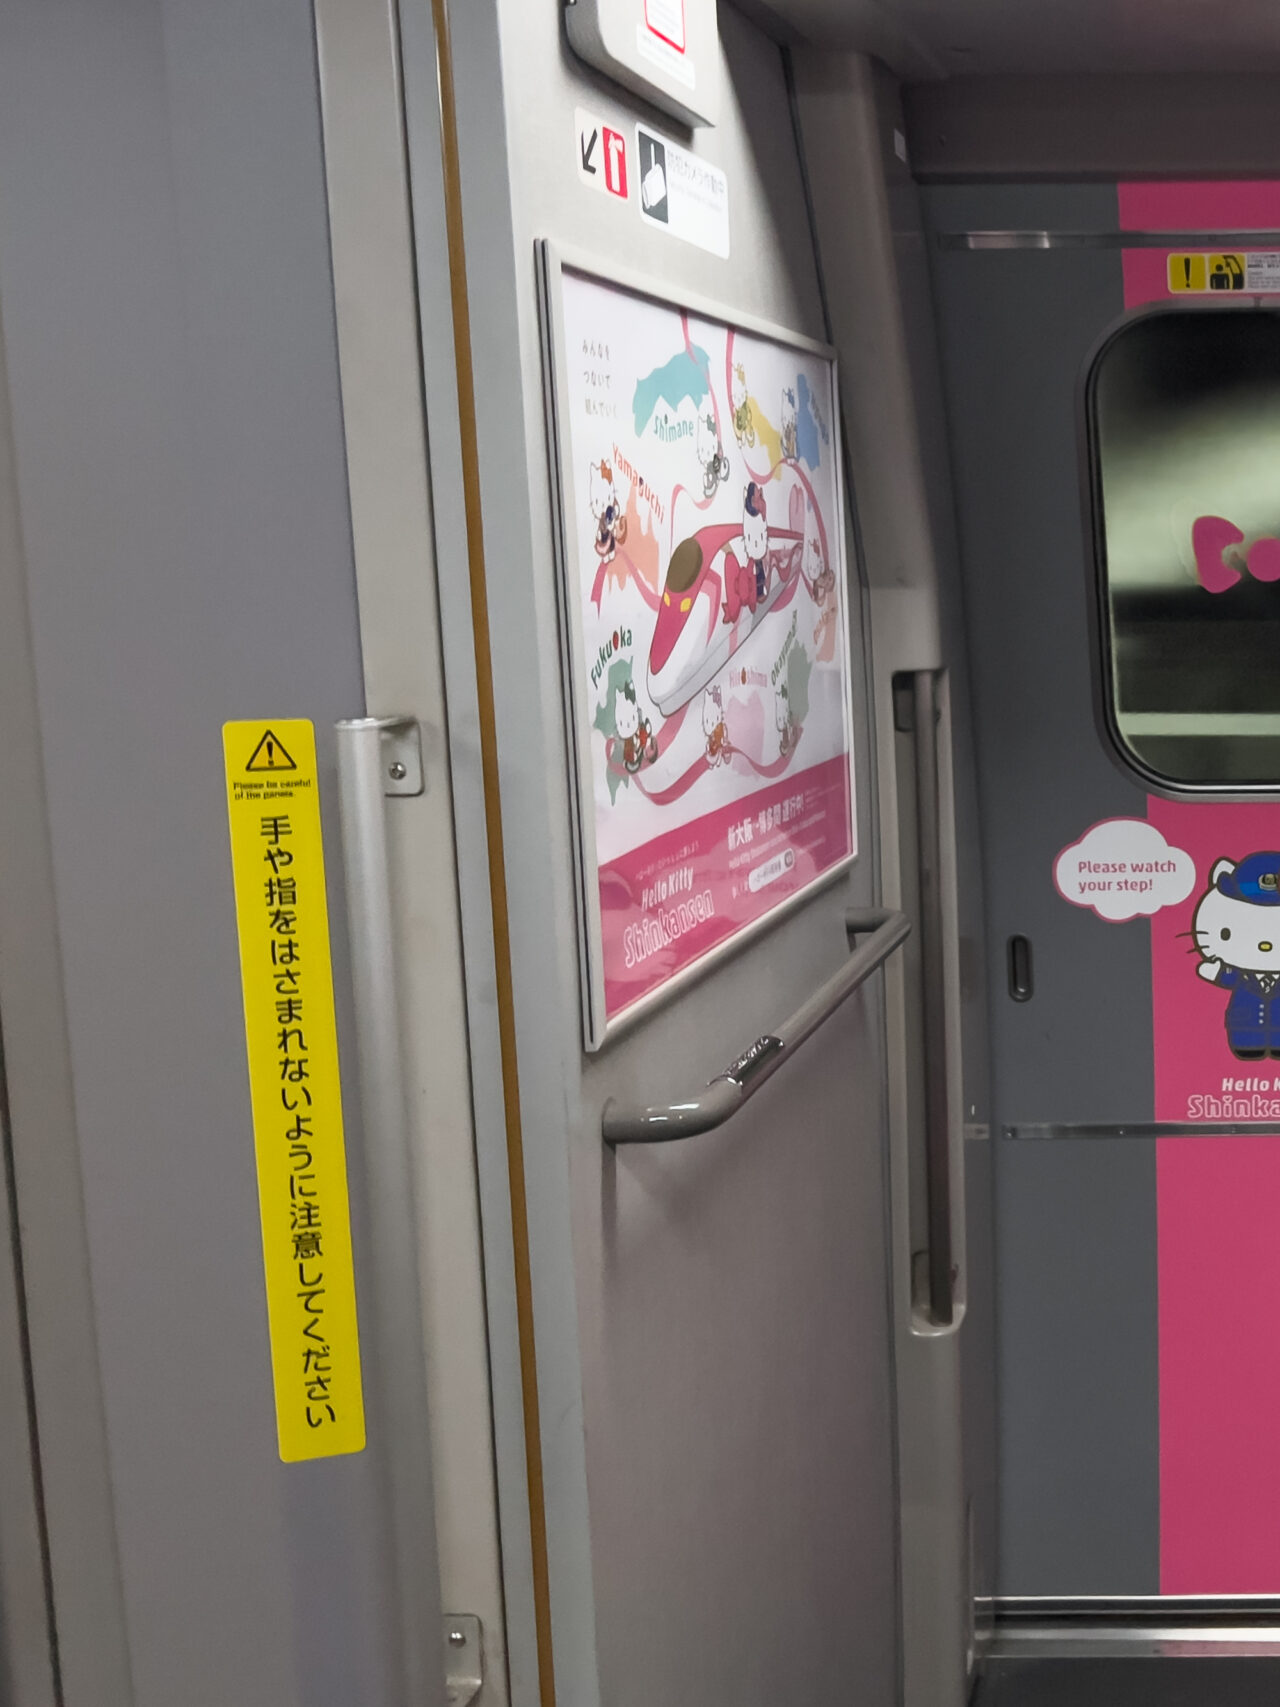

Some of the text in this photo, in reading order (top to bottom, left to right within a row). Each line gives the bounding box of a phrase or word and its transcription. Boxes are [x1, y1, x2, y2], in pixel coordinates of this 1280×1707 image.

[653, 414, 694, 442] Shimane
[612, 441, 664, 525] Yamaguchi
[1078, 860, 1177, 873] Please watch
[641, 879, 668, 912] Hello
[668, 866, 694, 896] Kitty
[1078, 879, 1153, 895] your step!
[623, 889, 715, 969] Shinkansen
[1221, 1077, 1270, 1092] Hello
[259, 814, 337, 1429] 手や指をはさまれないように注意してください
